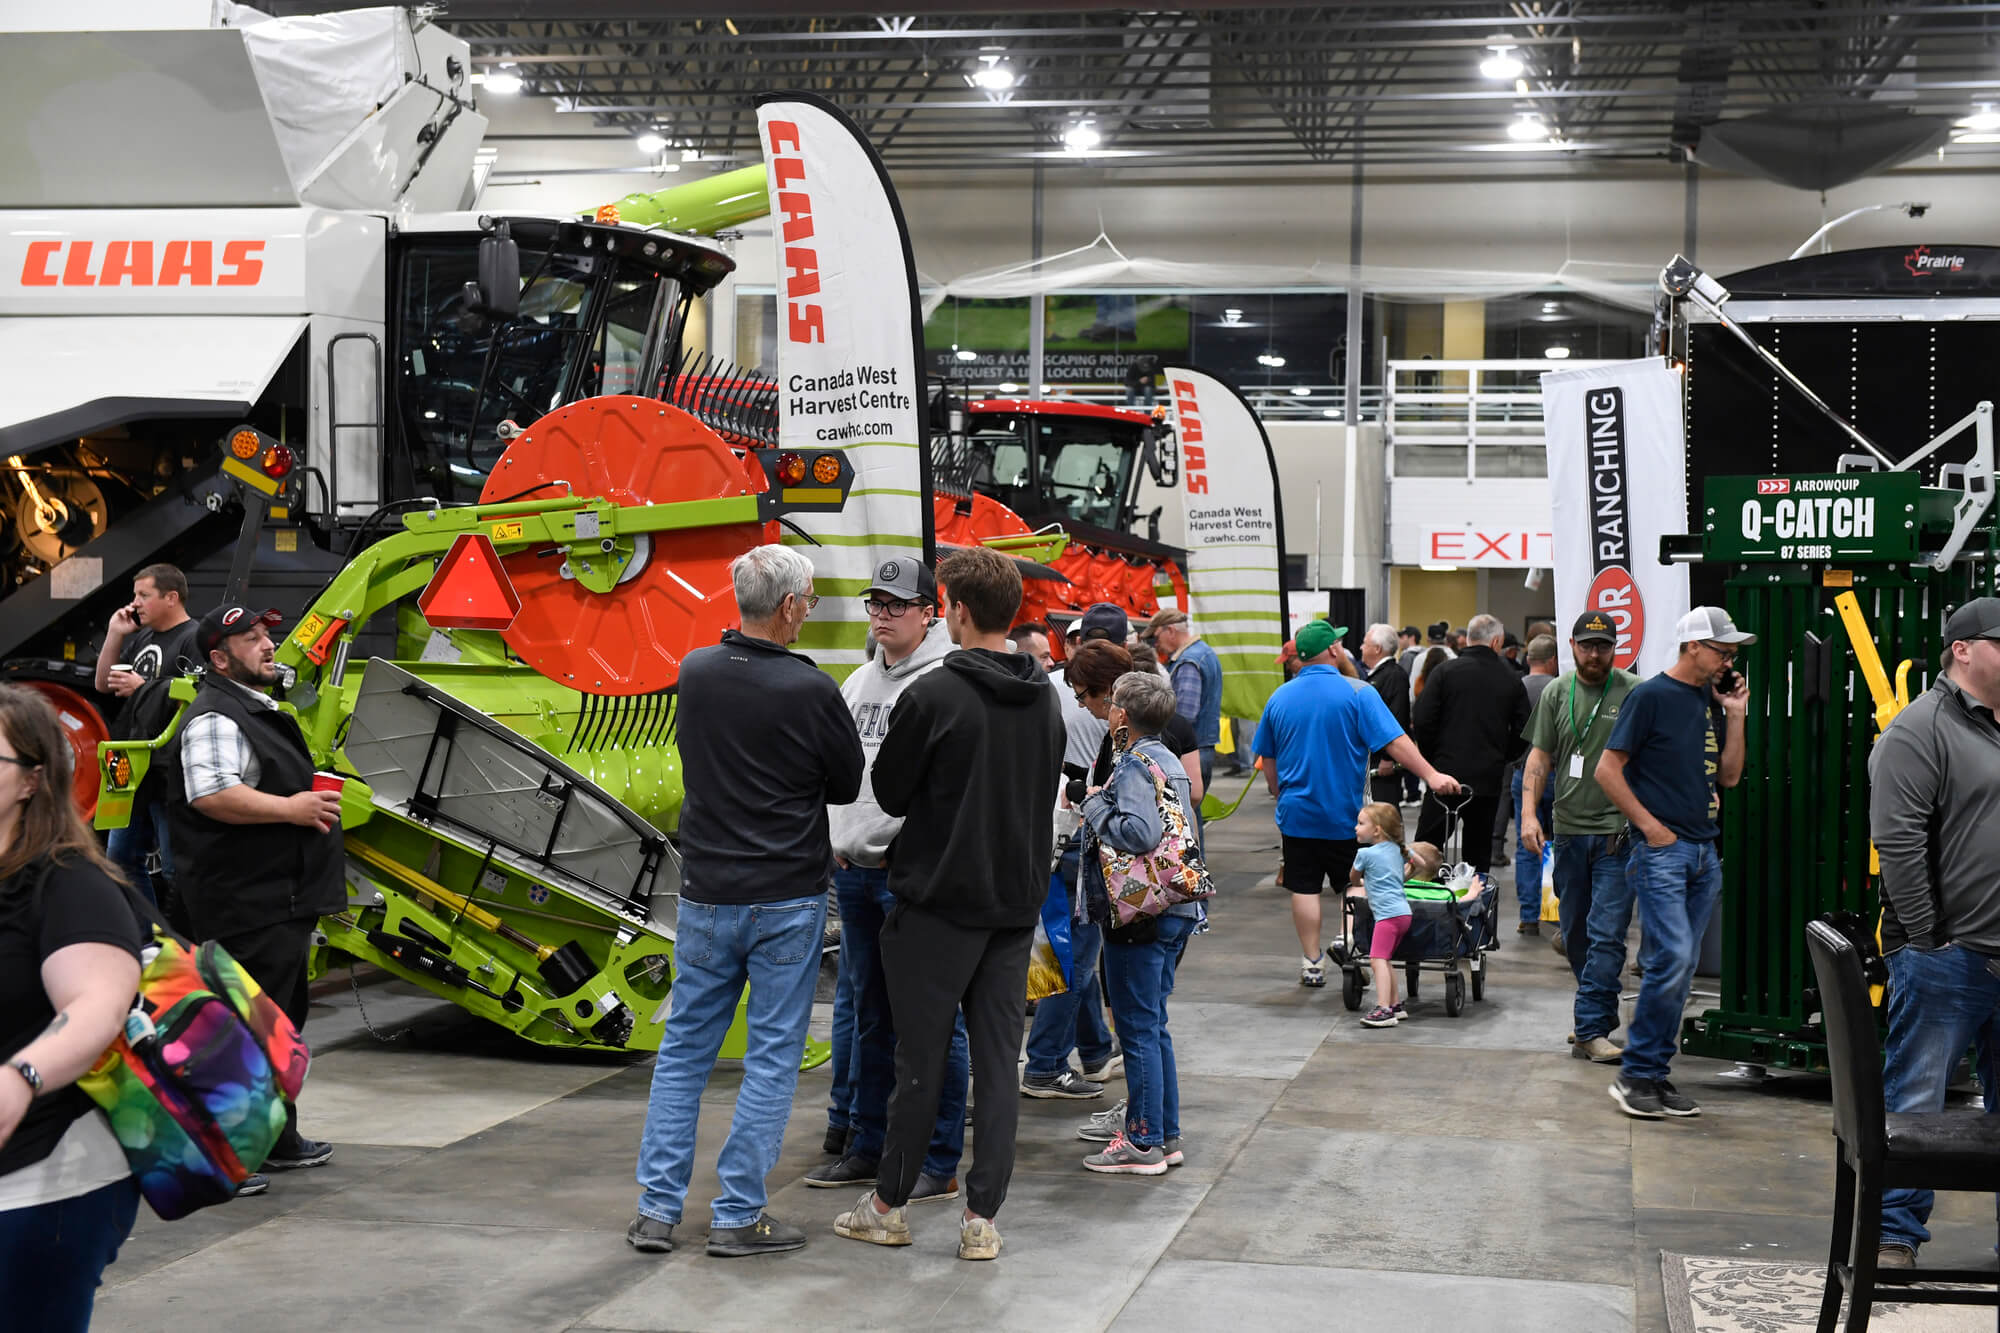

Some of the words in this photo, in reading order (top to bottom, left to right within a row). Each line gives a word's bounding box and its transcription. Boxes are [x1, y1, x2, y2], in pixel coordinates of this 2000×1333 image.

[768, 120, 825, 344] CLAAS
[20, 240, 266, 287] CLAAS
[998, 355, 1008, 365] A
[789, 369, 854, 393] Canada
[857, 365, 897, 385] West
[951, 367, 1003, 379] REQUEST
[1006, 367, 1016, 378] A
[1047, 367, 1092, 378] LOCATE
[1095, 367, 1128, 378] ONLI
[790, 392, 857, 416] Harvest
[860, 390, 910, 410] Centre
[816, 421, 893, 441] cawhc.com
[1173, 379, 1209, 495] CLAAS
[1591, 391, 1624, 561] RANCHING
[1794, 479, 1860, 492] ARROWQUIP
[1189, 508, 1231, 519] Canada
[1233, 507, 1262, 517] West
[1741, 497, 1874, 542] Q-CATCH
[1189, 520, 1232, 531] Harvest
[1235, 519, 1272, 529] Centre
[1203, 533, 1261, 543] cawhc.com
[1797, 545, 1832, 559] SERIES
